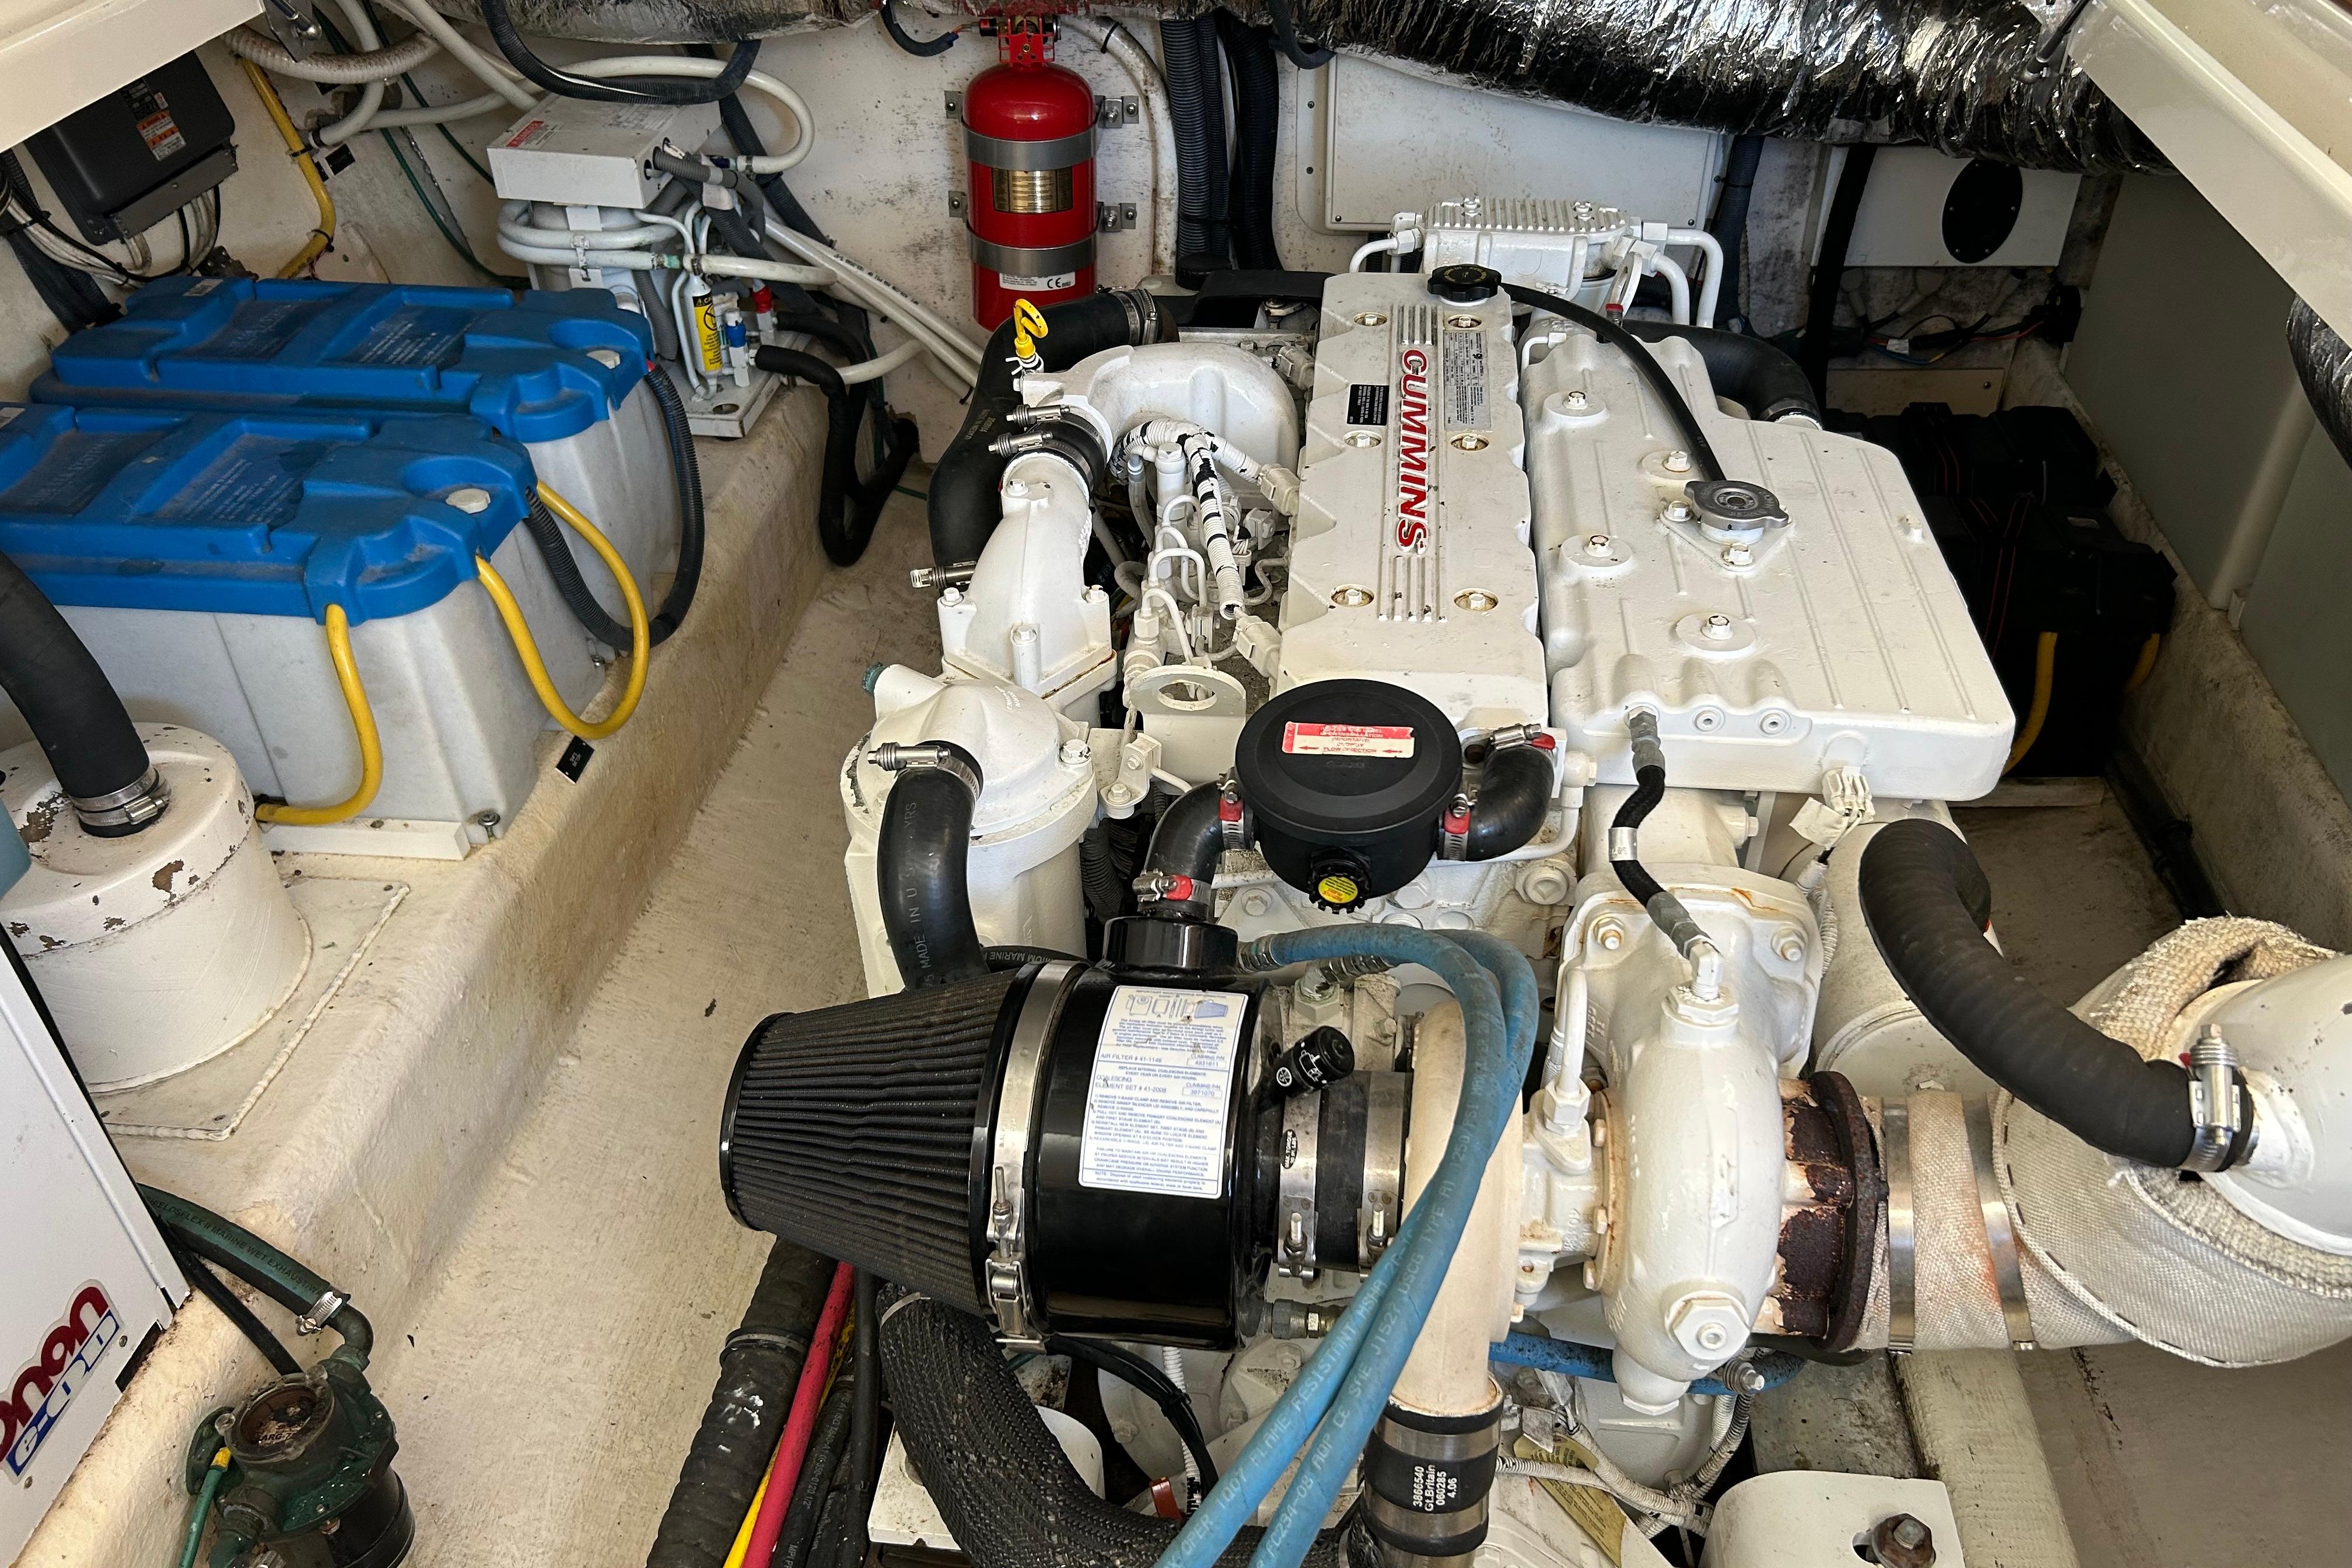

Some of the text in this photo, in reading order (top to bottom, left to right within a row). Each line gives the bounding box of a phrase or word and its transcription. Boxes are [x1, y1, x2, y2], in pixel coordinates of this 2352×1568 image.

[1398, 349, 1429, 552] CUMMINS
[909, 907, 921, 923] IN
[914, 935, 932, 969] MADE
[989, 952, 1026, 961] MARINE
[212, 1226, 249, 1250] MARINE
[247, 1246, 267, 1262] WET
[1180, 1514, 1214, 1555] OPER
[1250, 1416, 1291, 1467] FLAME
[1413, 1465, 1424, 1507] 3866540
[1424, 1464, 1436, 1512] Gt.Britain
[1436, 1471, 1447, 1506] 060285
[1447, 1478, 1457, 1498] 4.06
